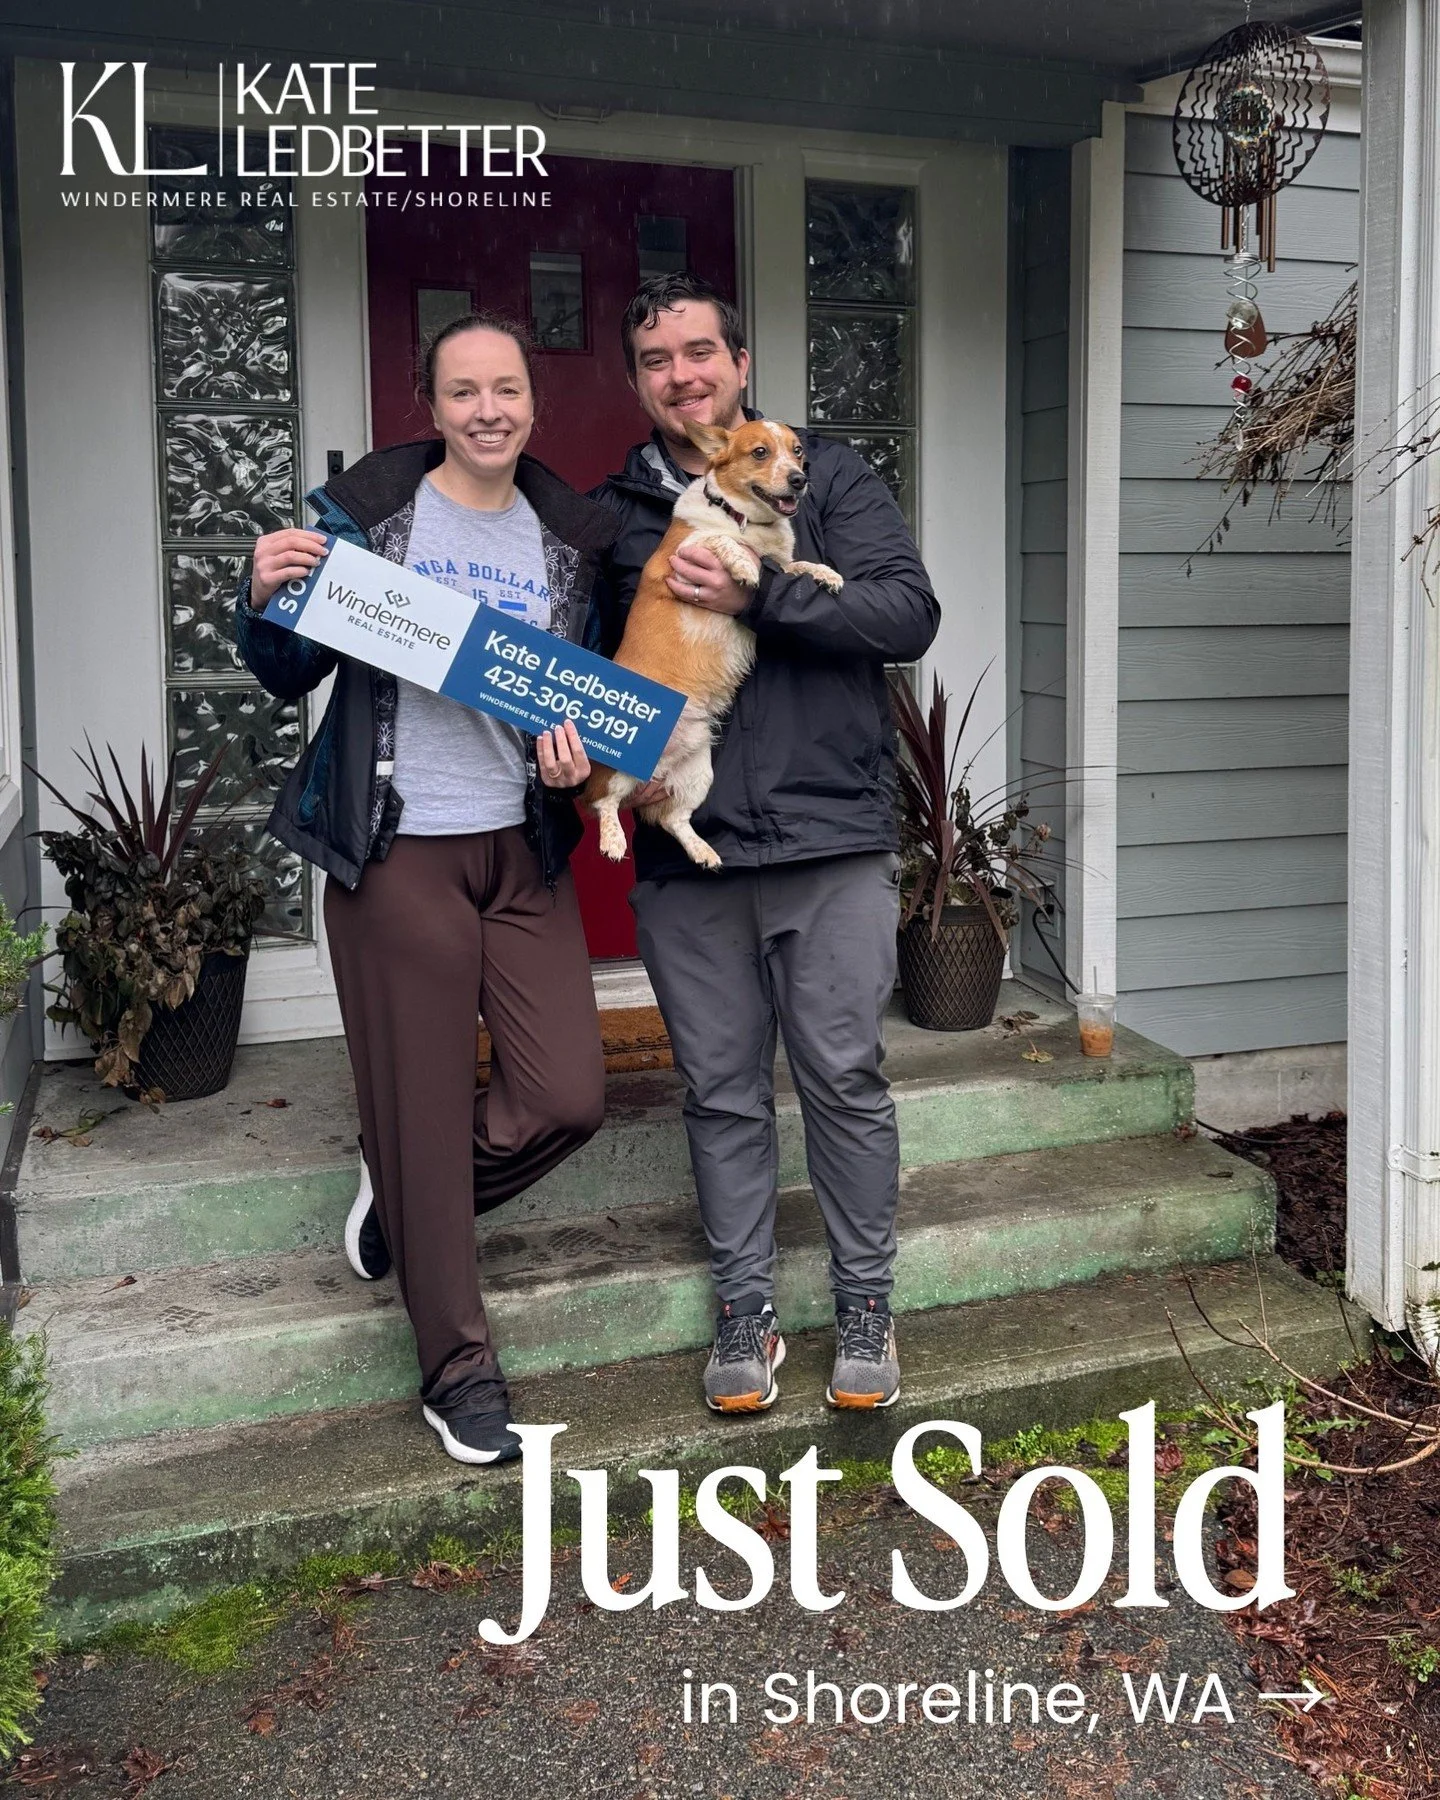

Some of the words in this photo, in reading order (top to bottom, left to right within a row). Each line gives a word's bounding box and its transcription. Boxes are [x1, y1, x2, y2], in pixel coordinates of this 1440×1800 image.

[410, 559, 459, 577] NGA
[327, 580, 451, 650] Windermere
[347, 615, 373, 632] REAL
[377, 629, 416, 650] ESTATE
[484, 629, 541, 671] Kate
[545, 657, 661, 723] Ledbetter
[479, 691, 530, 719] WINDERMERE
[530, 713, 549, 728] REAL
[484, 665, 639, 744] 425-306-9191
[581, 736, 623, 759] SHORELINE
